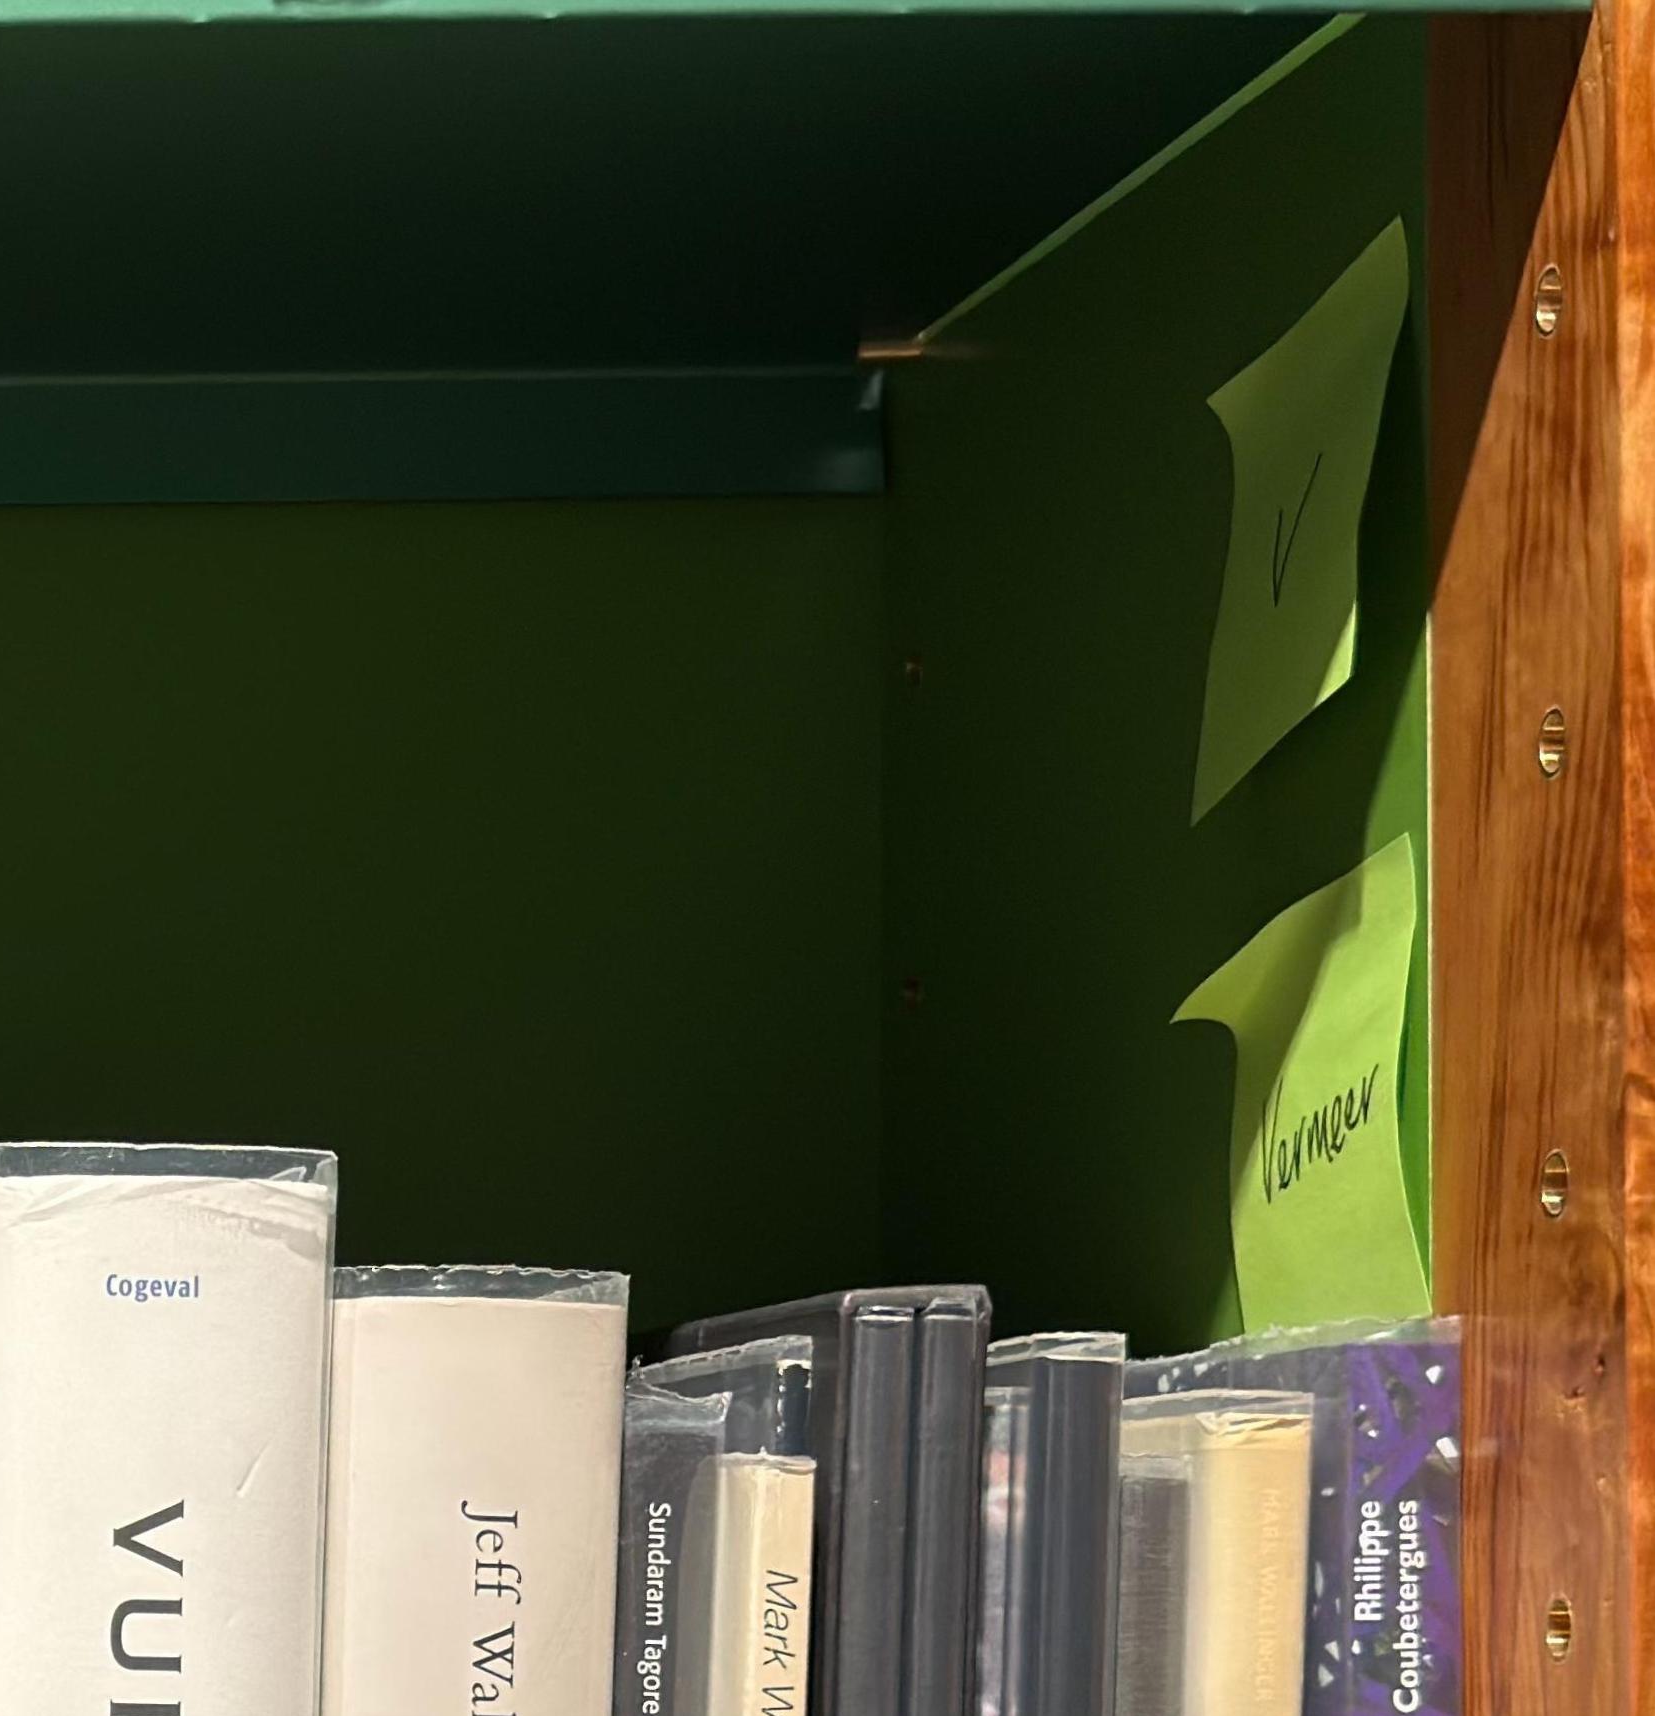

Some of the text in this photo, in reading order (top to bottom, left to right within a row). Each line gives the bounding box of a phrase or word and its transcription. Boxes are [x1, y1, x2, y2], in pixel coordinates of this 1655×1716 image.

[1262, 1064, 1380, 1204] Vermeer
[105, 1273, 201, 1305] Cogeval
[462, 1498, 524, 1604] Jeff
[643, 1501, 671, 1627] Sundaram
[767, 1568, 798, 1665] Mark
[1393, 1500, 1426, 1713] Coubetergues
[638, 1635, 667, 1714] Tagore
